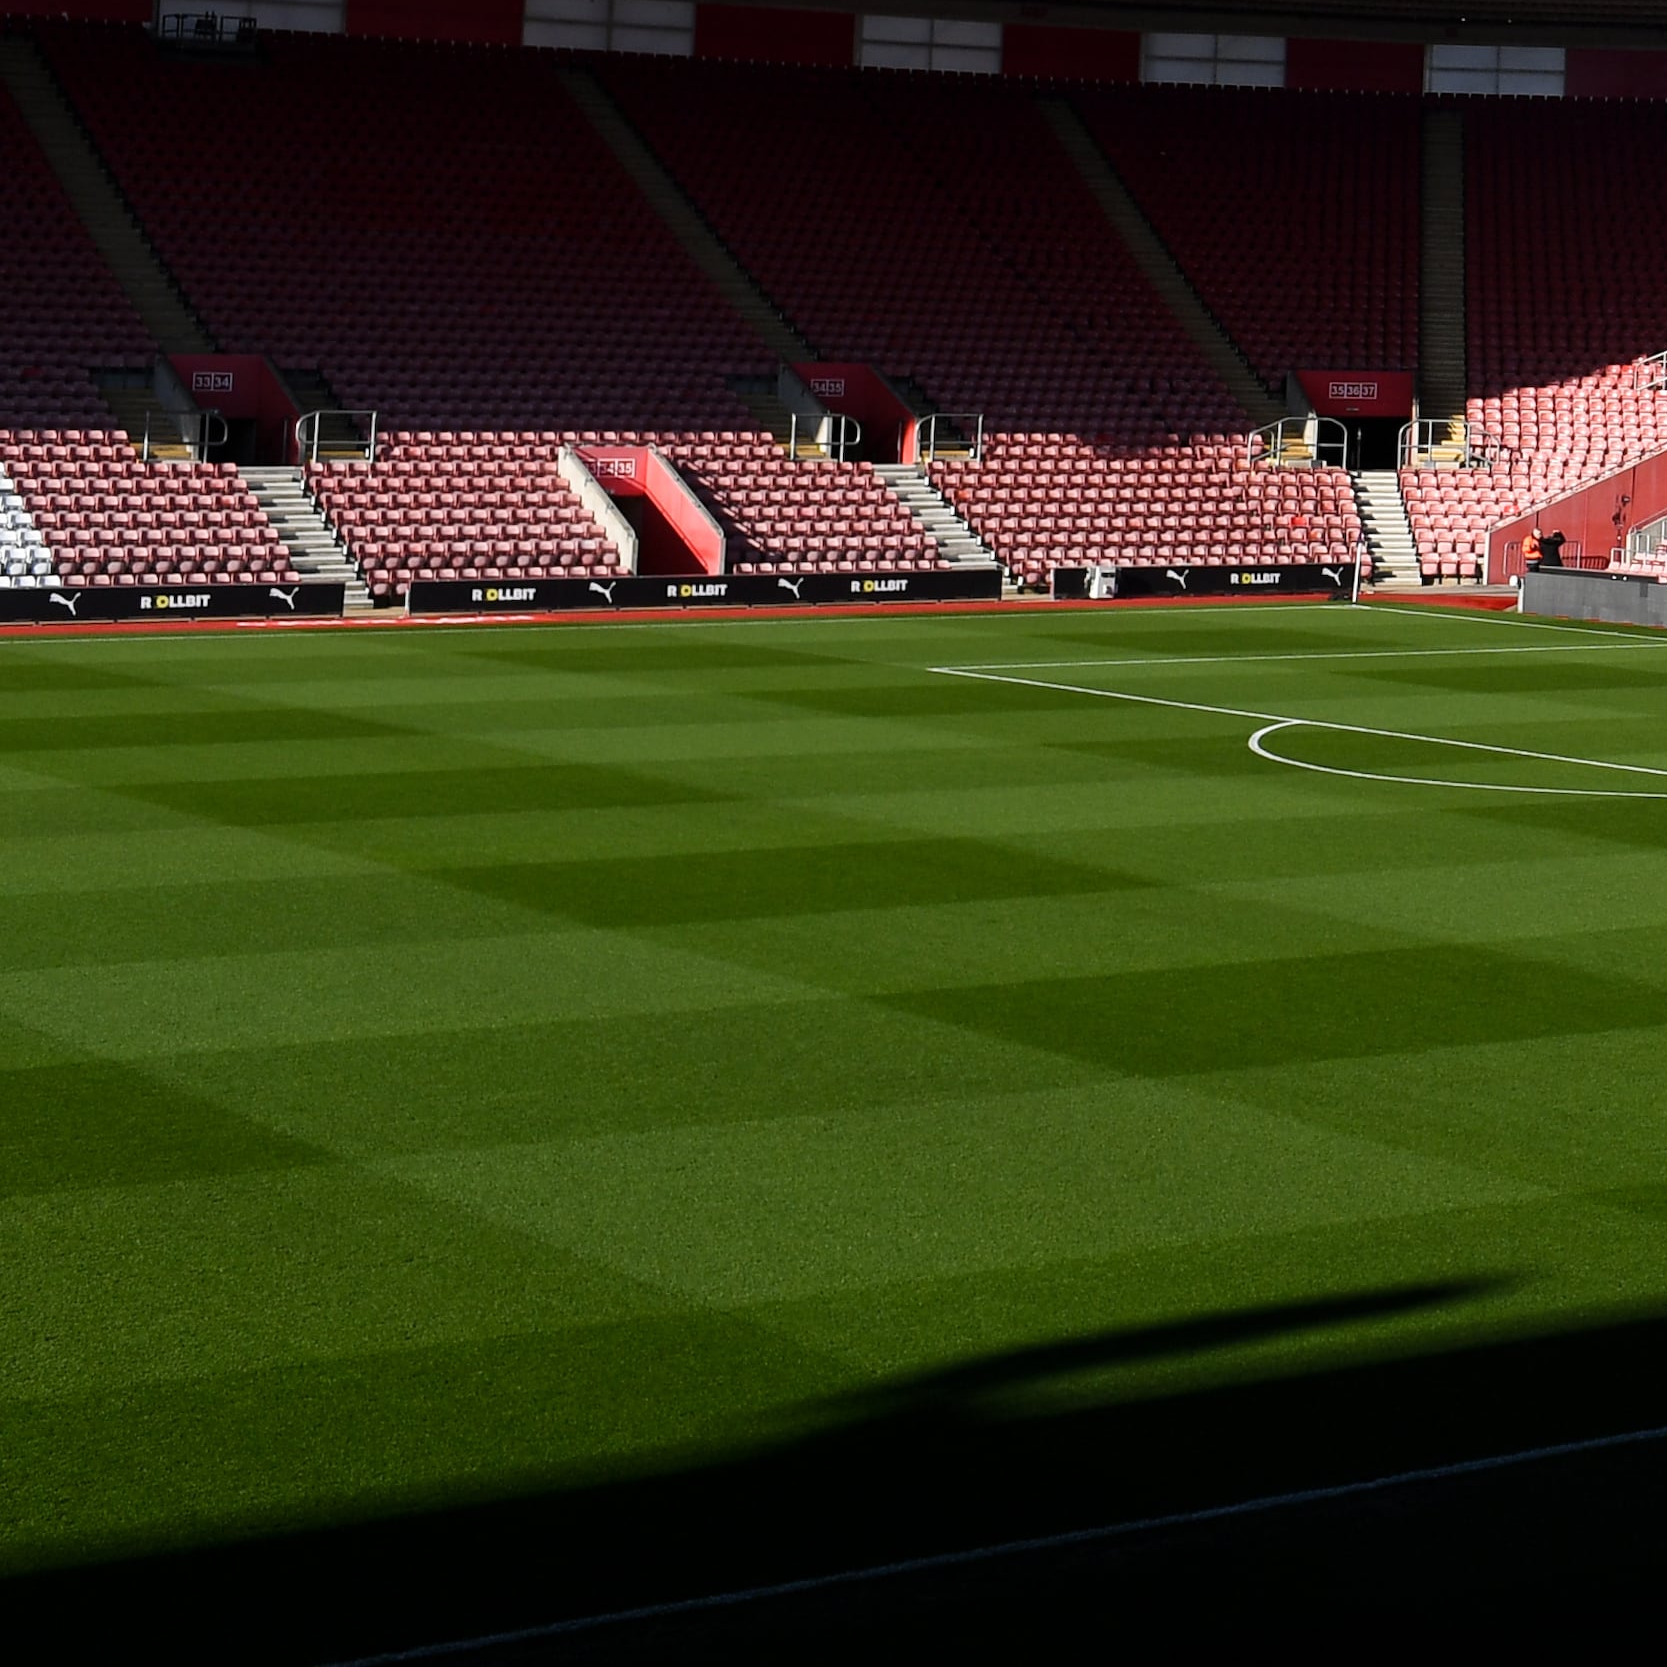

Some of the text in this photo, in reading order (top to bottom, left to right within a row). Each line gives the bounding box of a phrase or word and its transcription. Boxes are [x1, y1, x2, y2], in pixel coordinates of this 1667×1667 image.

[195, 376, 229, 388] 33 34
[1230, 572, 1281, 585] ROLLBIT
[667, 583, 728, 597] ROLLBIT
[850, 579, 908, 593] ROLLBIT
[140, 593, 211, 610] ROLLBIT
[471, 587, 537, 602] ROLLBIT
